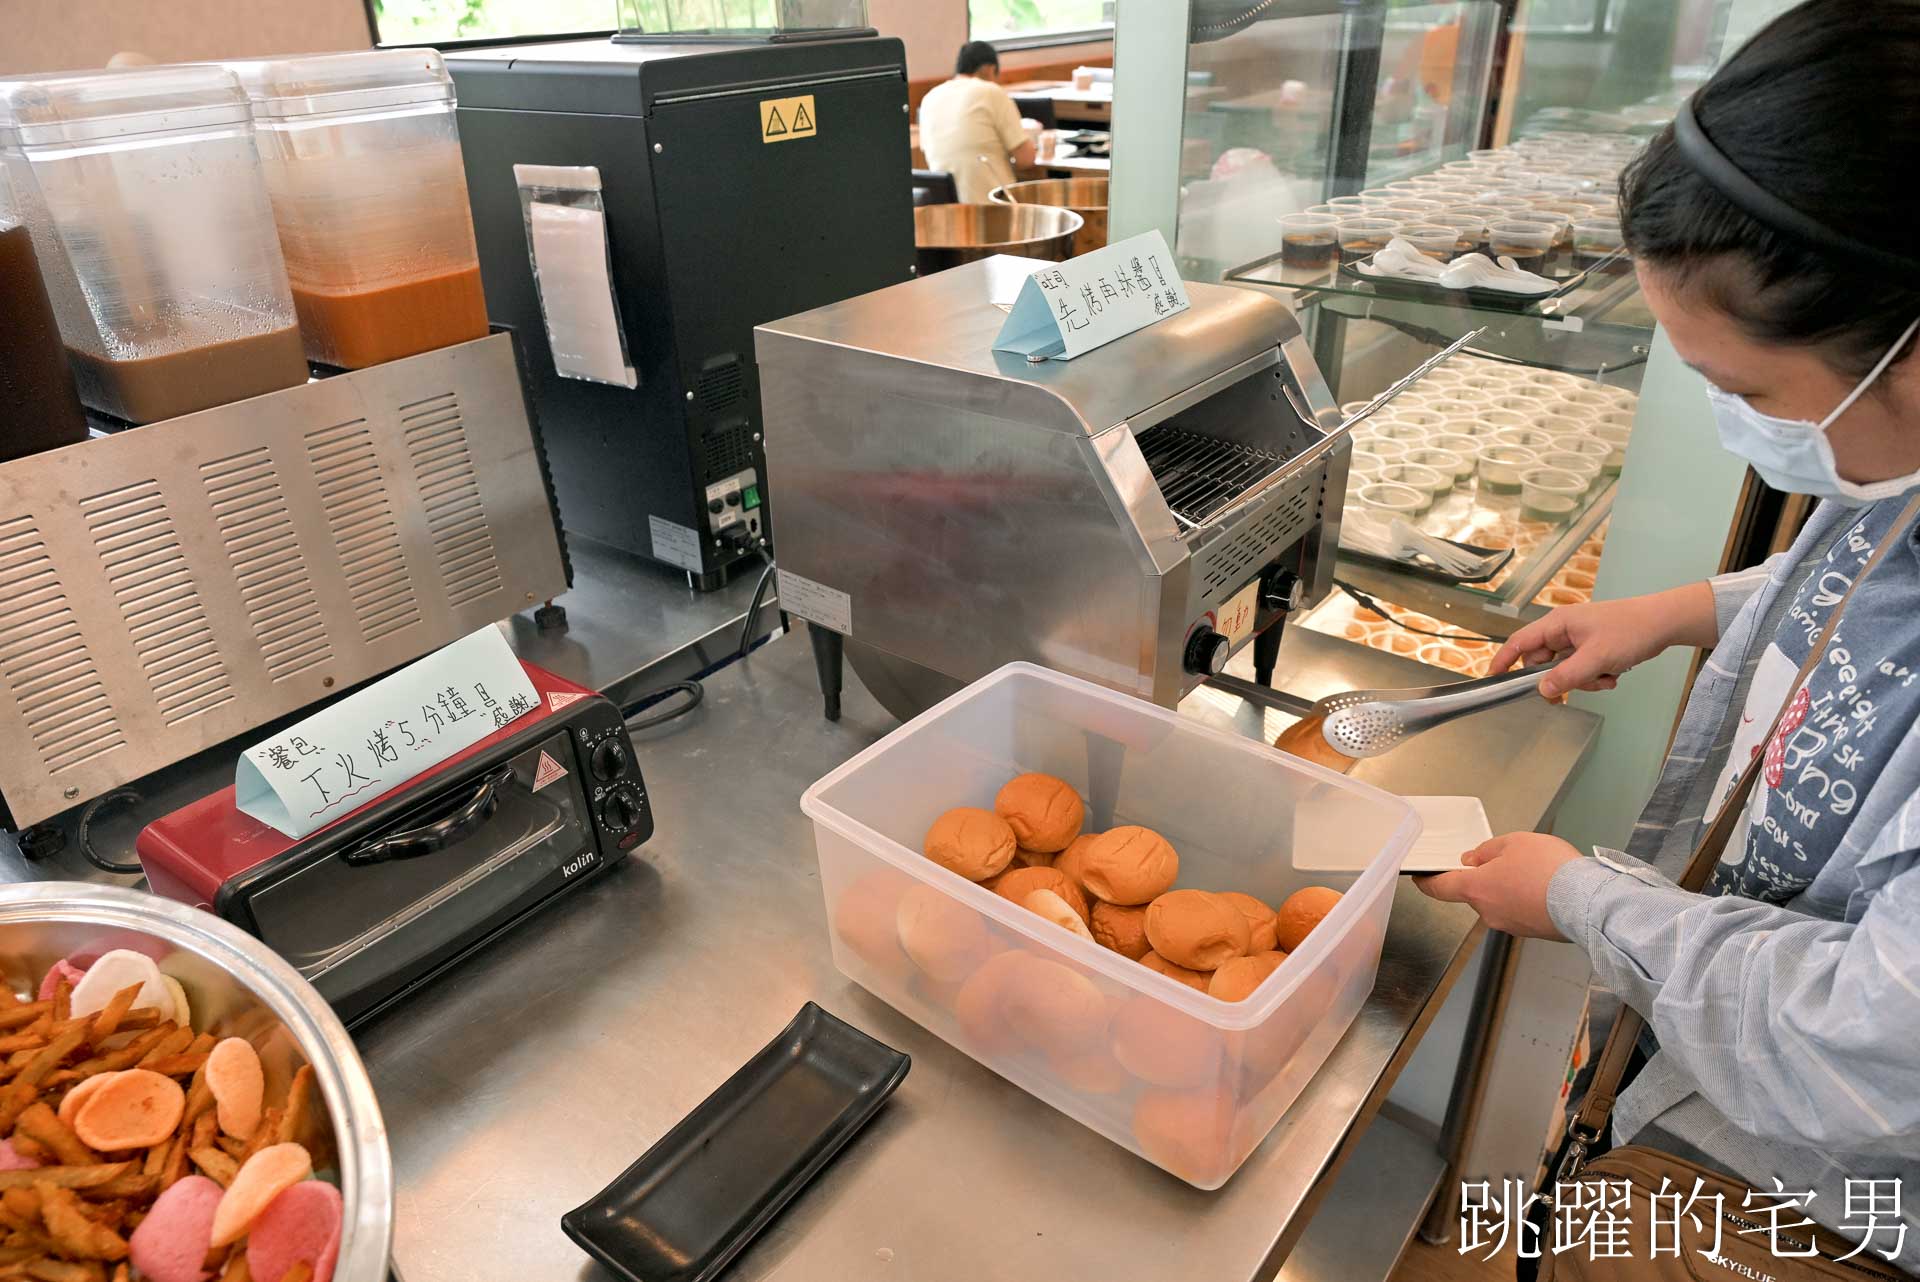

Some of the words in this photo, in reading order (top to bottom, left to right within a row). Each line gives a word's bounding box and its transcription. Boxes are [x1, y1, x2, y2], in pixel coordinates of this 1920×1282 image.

[493, 694, 530, 728] 感謝
[268, 736, 318, 770] 餐包
[562, 852, 594, 878] kolin
